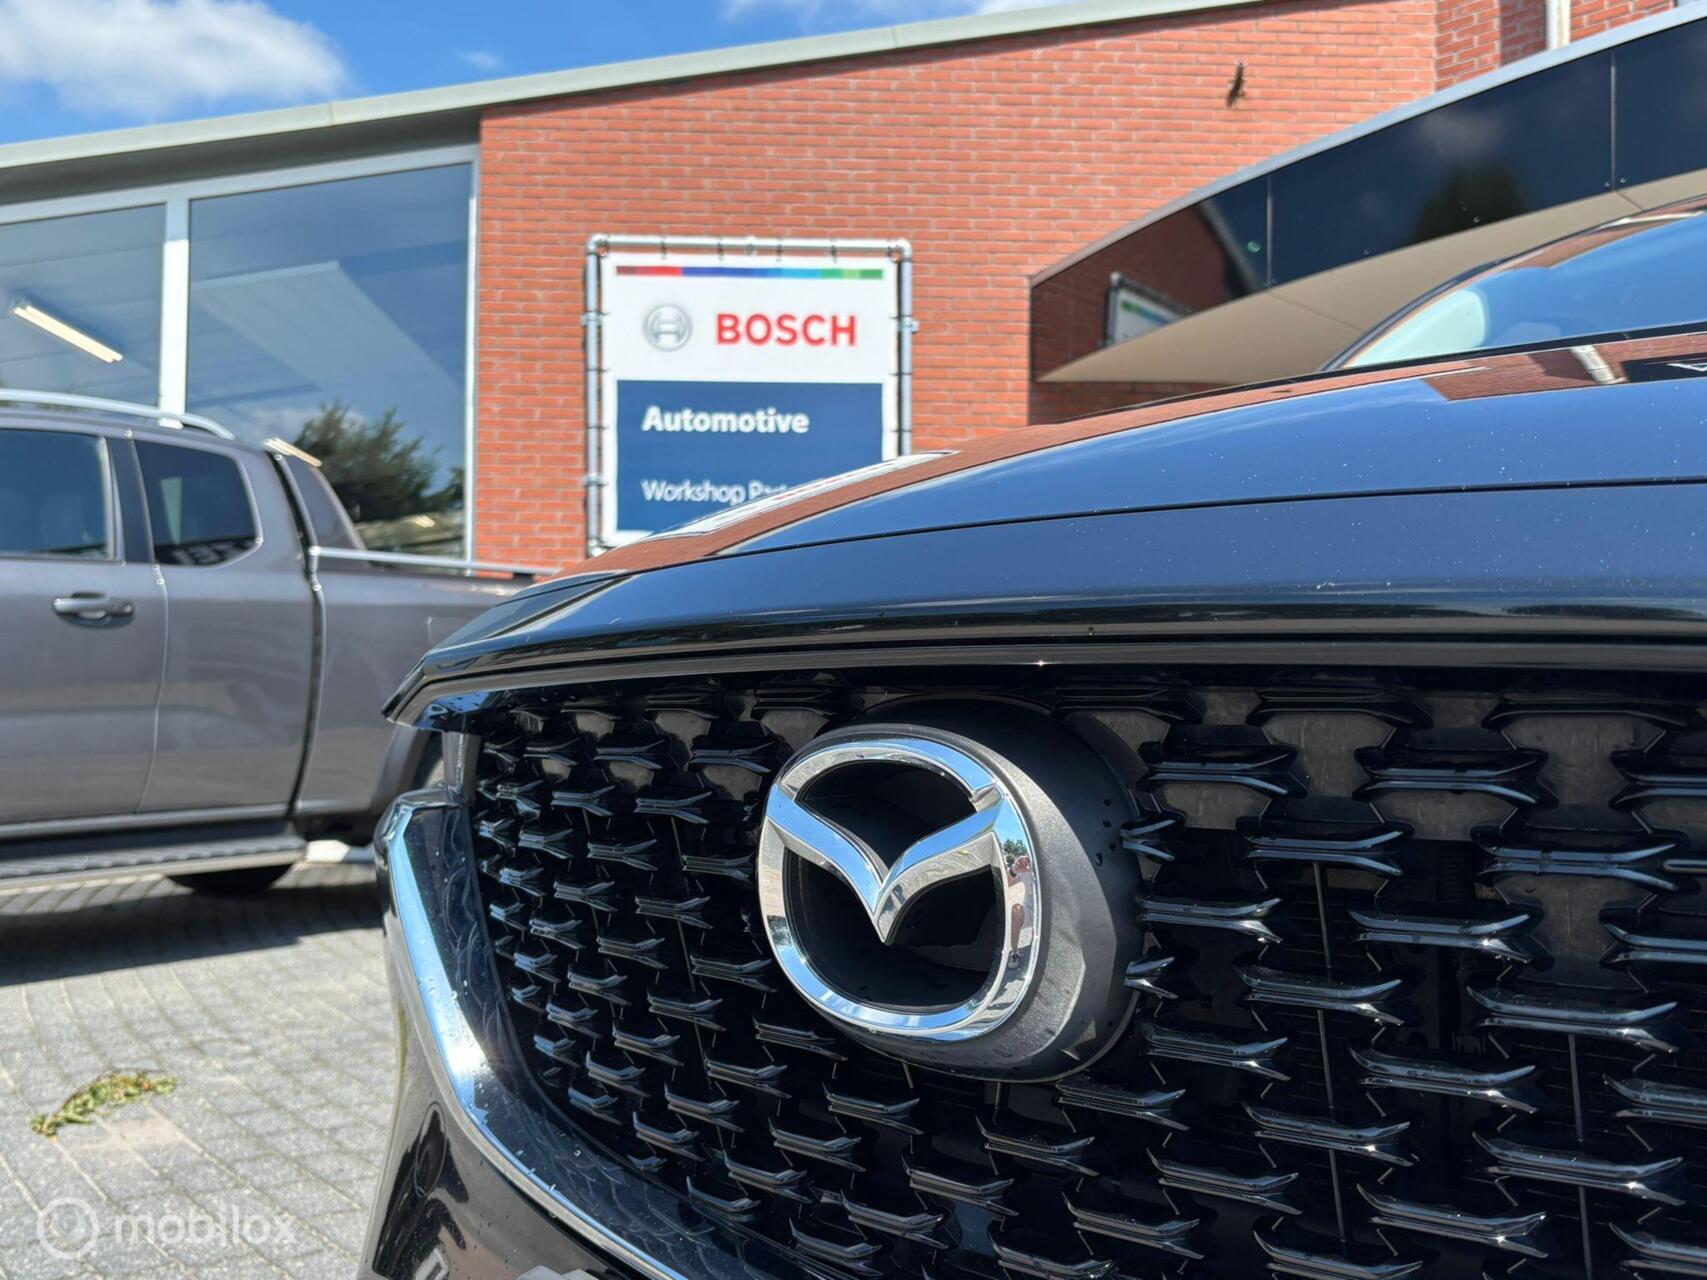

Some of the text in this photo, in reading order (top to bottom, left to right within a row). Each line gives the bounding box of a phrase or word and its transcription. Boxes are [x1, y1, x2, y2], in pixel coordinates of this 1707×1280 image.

[716, 313, 856, 347] BOSCH
[641, 405, 810, 434] Automotive
[640, 479, 747, 506] Workshop
